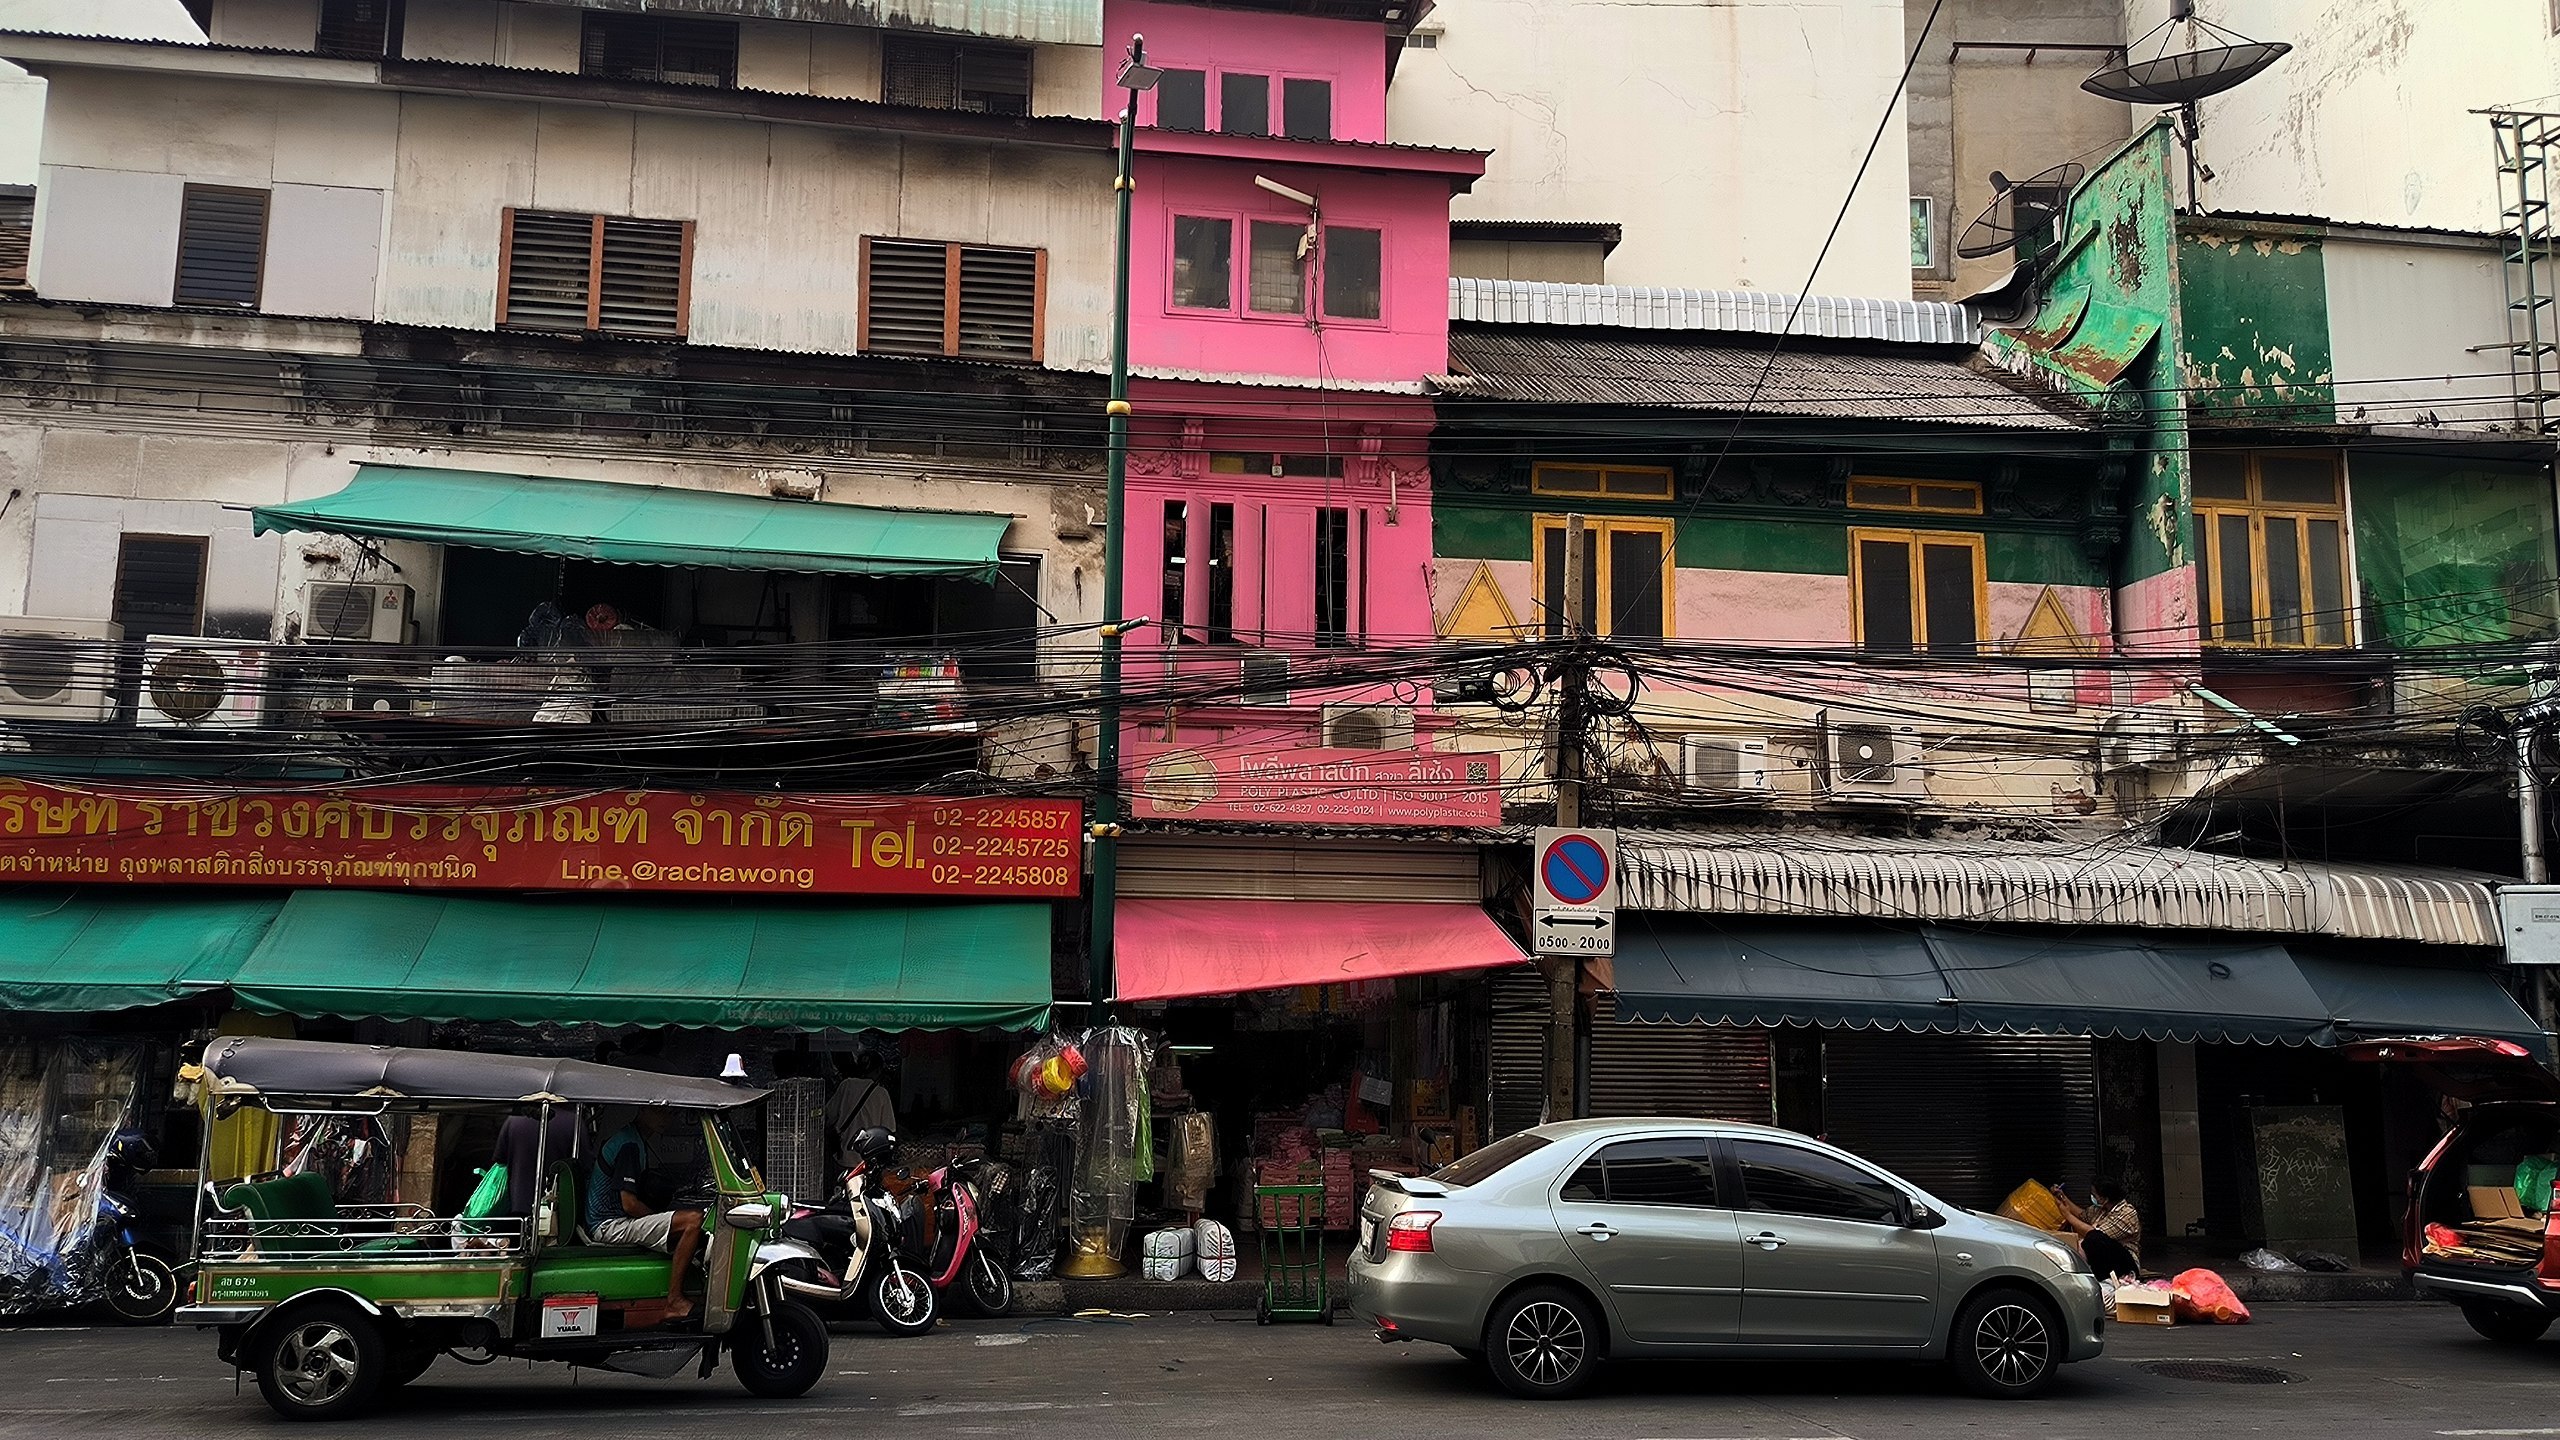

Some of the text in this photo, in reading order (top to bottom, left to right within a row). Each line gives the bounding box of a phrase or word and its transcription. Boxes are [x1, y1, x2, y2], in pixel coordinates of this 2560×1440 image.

[1240, 785, 1273, 797] POLY
[1277, 786, 1327, 799] PLASTIC
[1332, 787, 1380, 801] CO.,LTD.
[1392, 790, 1413, 801] ISO
[1419, 790, 1448, 802] 9001
[1461, 791, 1489, 803] 2015
[671, 791, 815, 848] จำกัด
[932, 806, 1071, 830] 02-2245857
[1317, 804, 1374, 815] 02-225-0124
[1388, 806, 1488, 818] www.polyplastic.co.th
[840, 819, 926, 870] Tel.
[931, 835, 1070, 858] 02-2245725
[561, 859, 815, 889] Line.@rachawong
[930, 863, 1069, 887] 02-2245808
[235, 1277, 256, 1286] 679
[556, 1325, 582, 1333] YUASA
